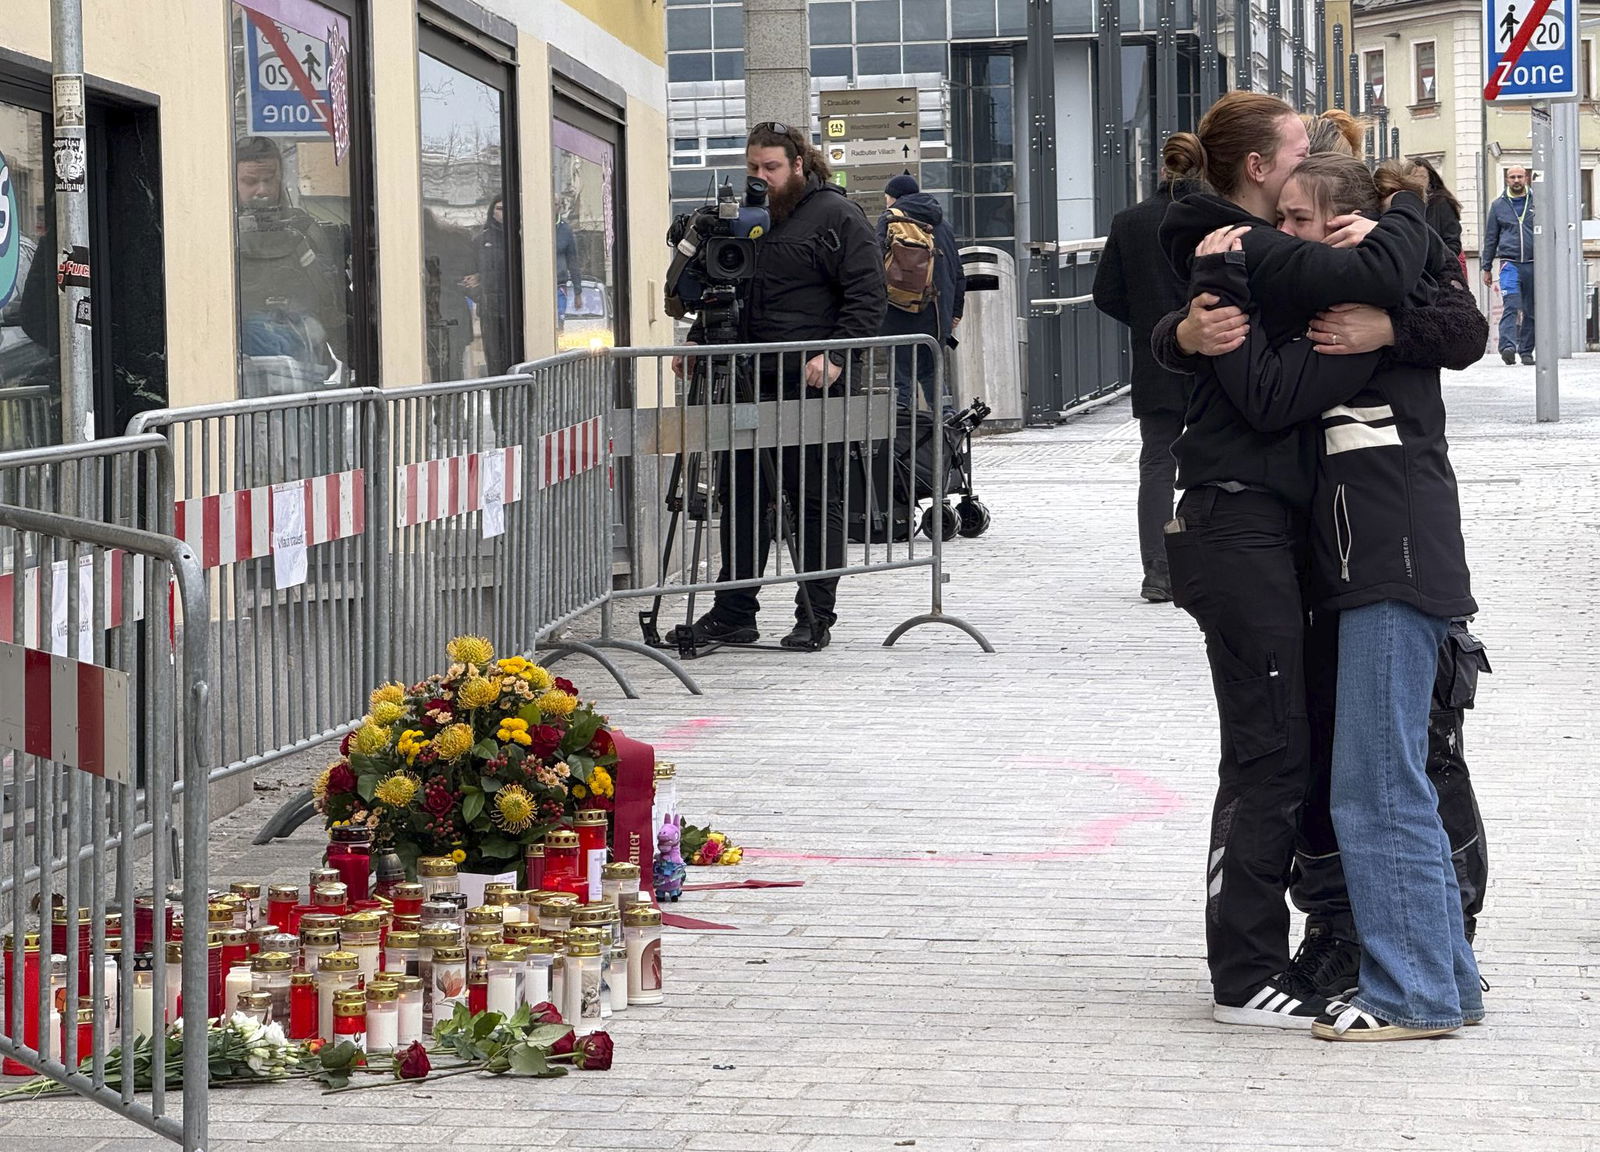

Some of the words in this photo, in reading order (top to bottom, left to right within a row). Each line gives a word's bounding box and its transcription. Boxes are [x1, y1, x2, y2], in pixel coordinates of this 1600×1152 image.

[1536, 22, 1560, 45] 20
[1497, 61, 1564, 86] Zone
[65, 260, 91, 278] FUC
